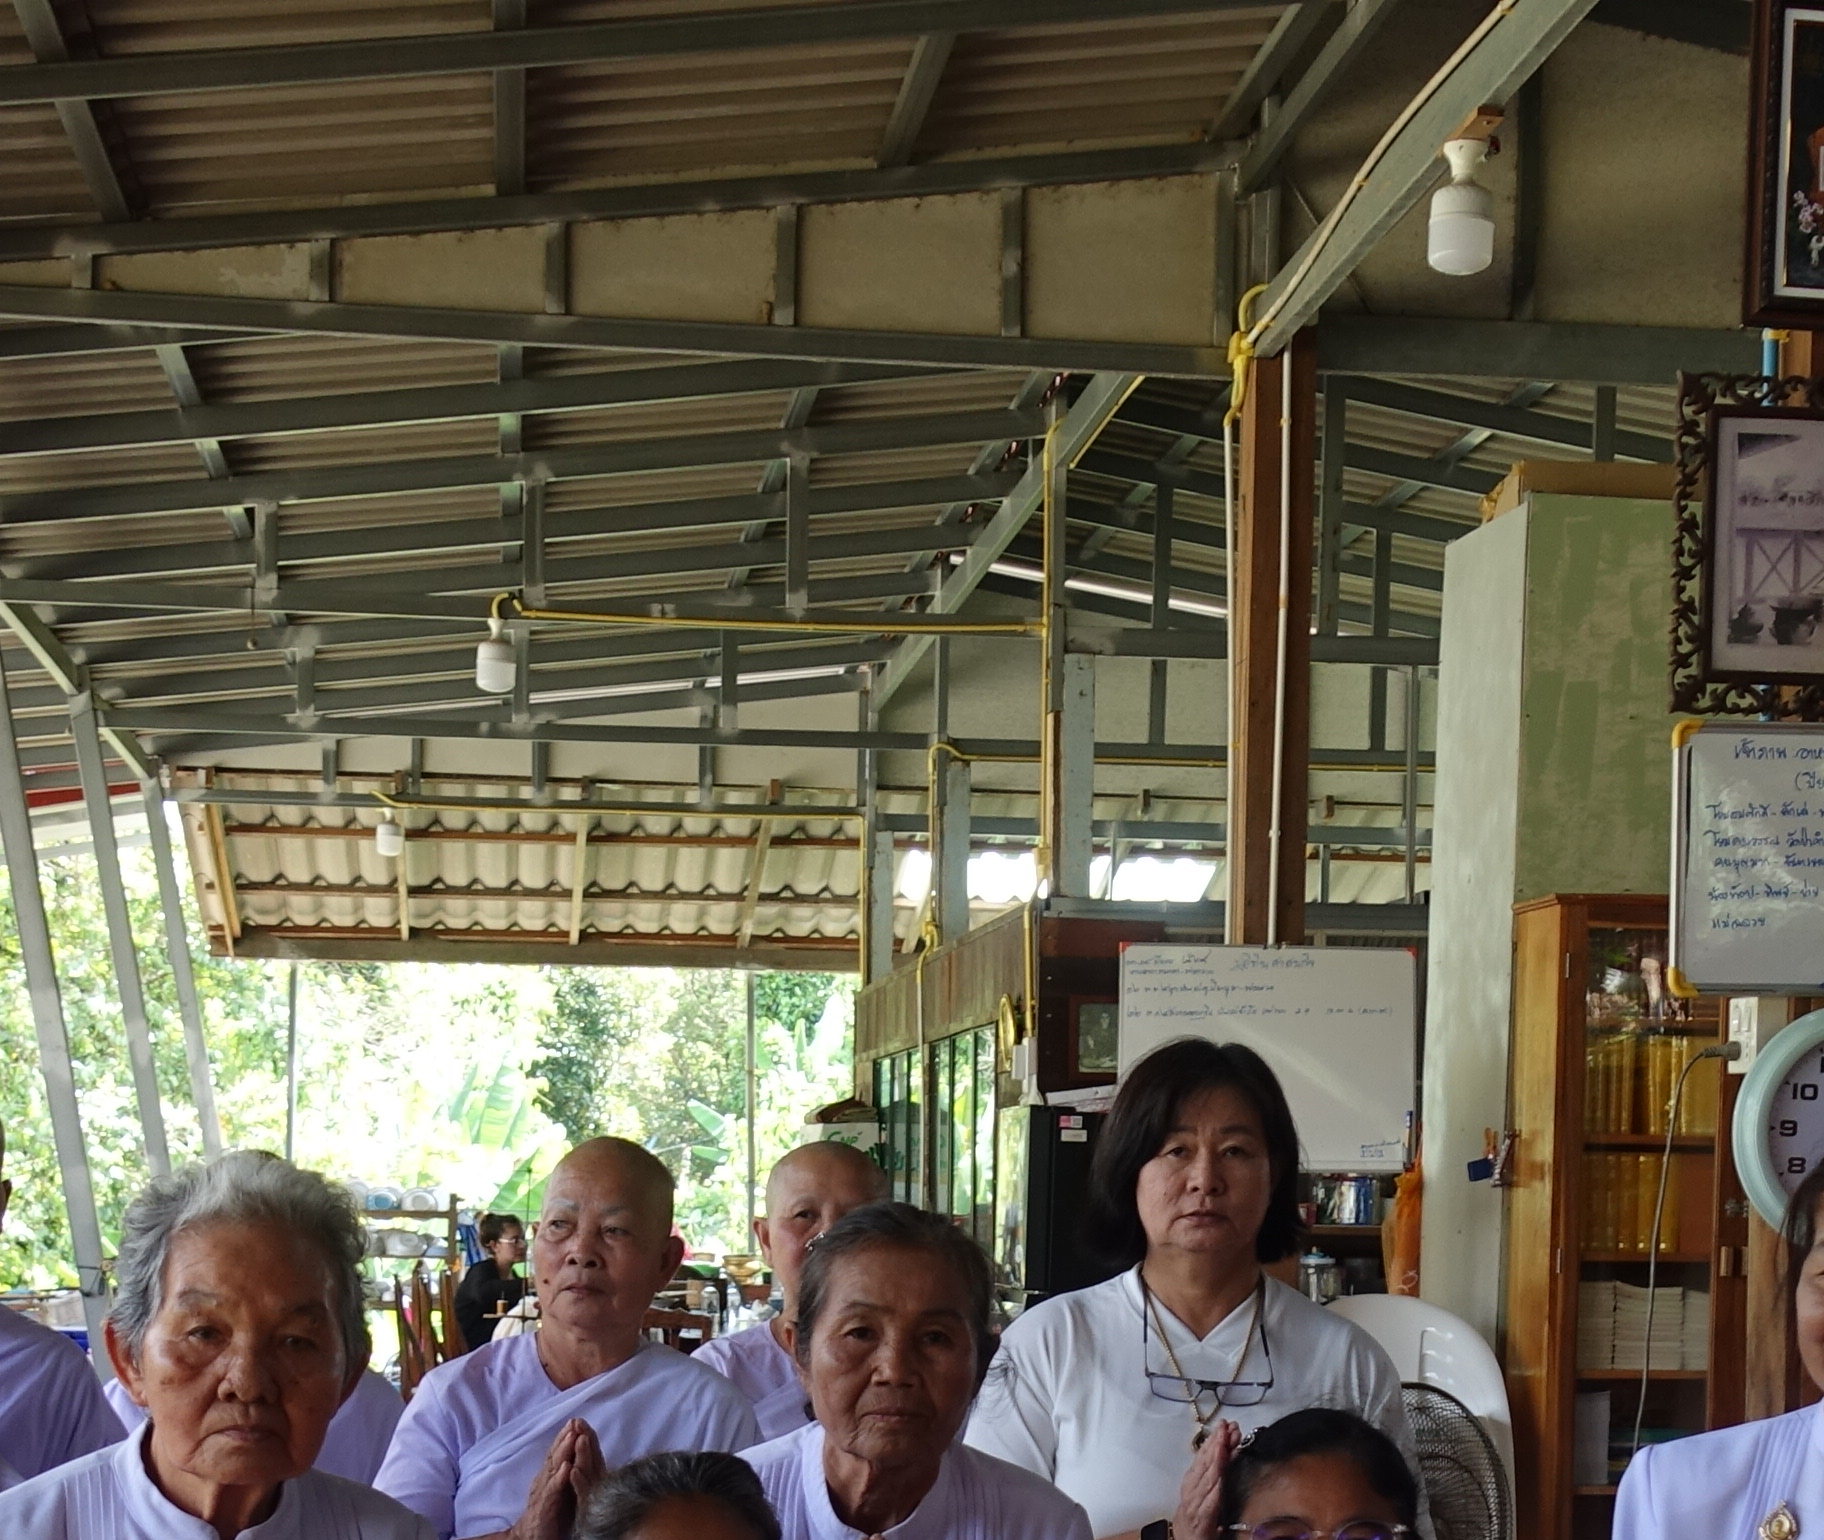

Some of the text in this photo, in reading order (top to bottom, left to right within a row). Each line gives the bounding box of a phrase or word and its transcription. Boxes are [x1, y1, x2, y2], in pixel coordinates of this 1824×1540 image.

[1792, 1082, 1819, 1101] 10
[1778, 1119, 1798, 1137] 9
[1787, 1156, 1806, 1174] 8
